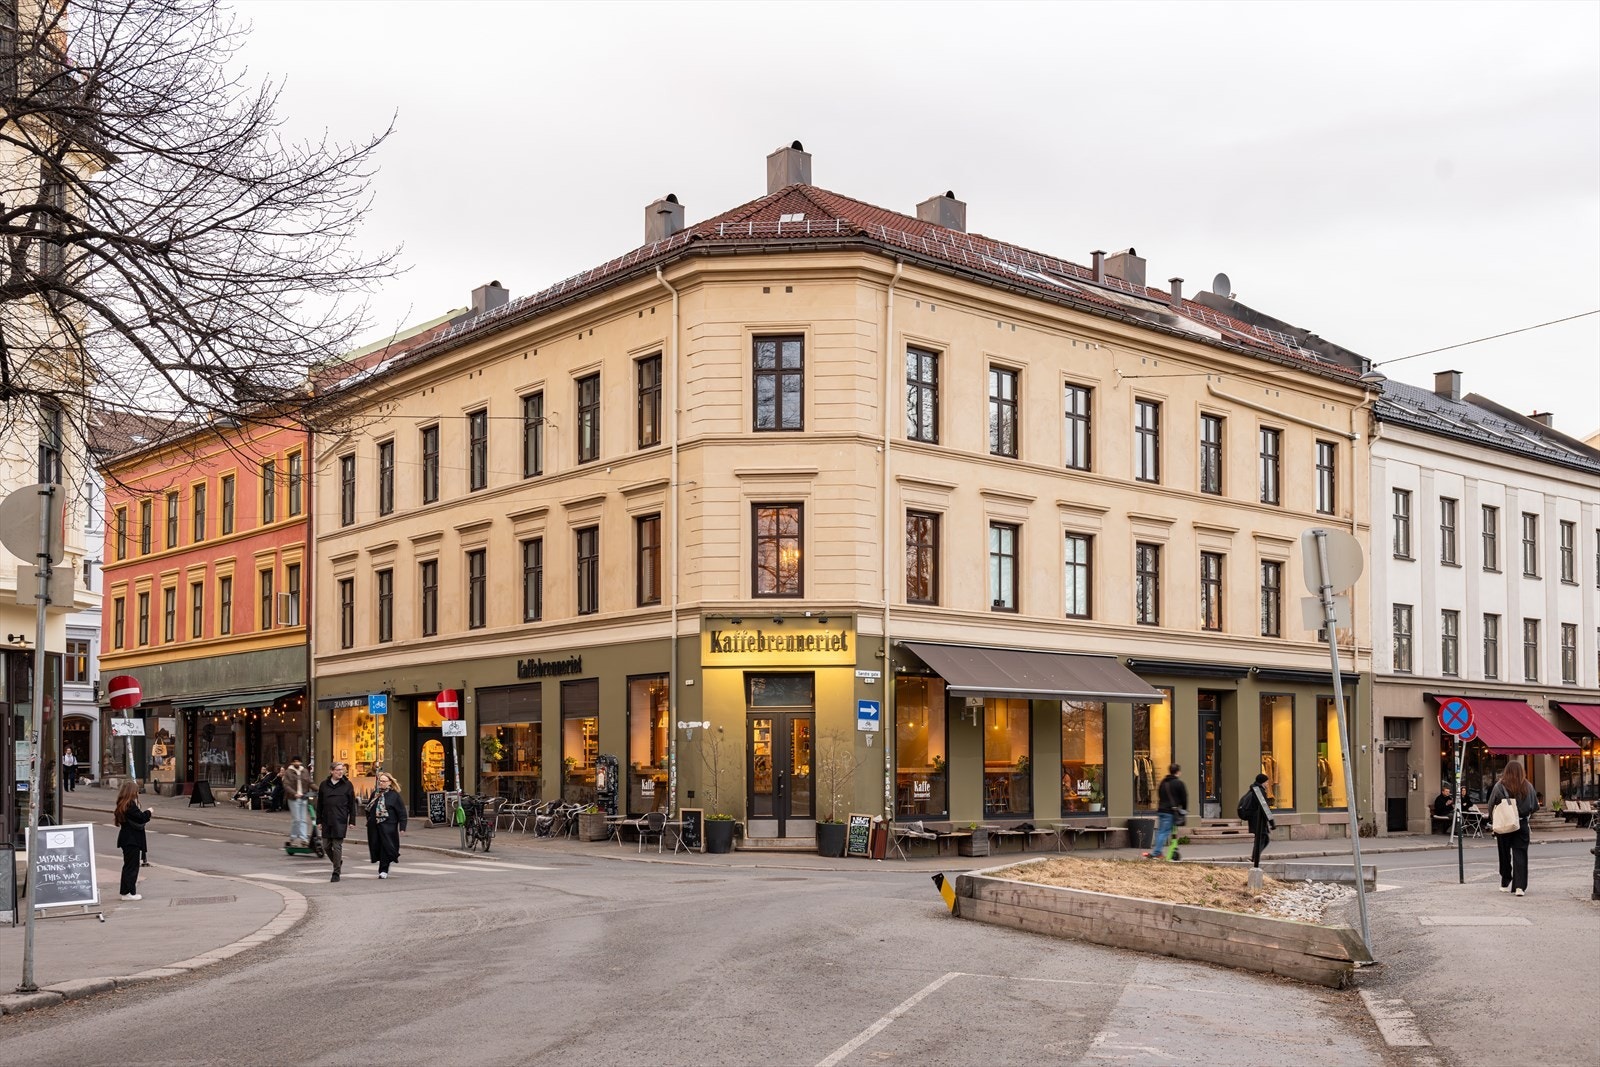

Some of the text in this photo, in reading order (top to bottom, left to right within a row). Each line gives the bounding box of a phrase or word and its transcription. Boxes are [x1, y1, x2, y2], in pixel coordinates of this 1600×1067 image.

[709, 630, 848, 653] Kaffebrenneriet
[914, 780, 930, 791] Kaffe
[36, 854, 80, 864] JAPANESE
[36, 864, 66, 873] DRINKS
[72, 861, 89, 869] FOOD
[43, 872, 80, 881] THIS WAY
